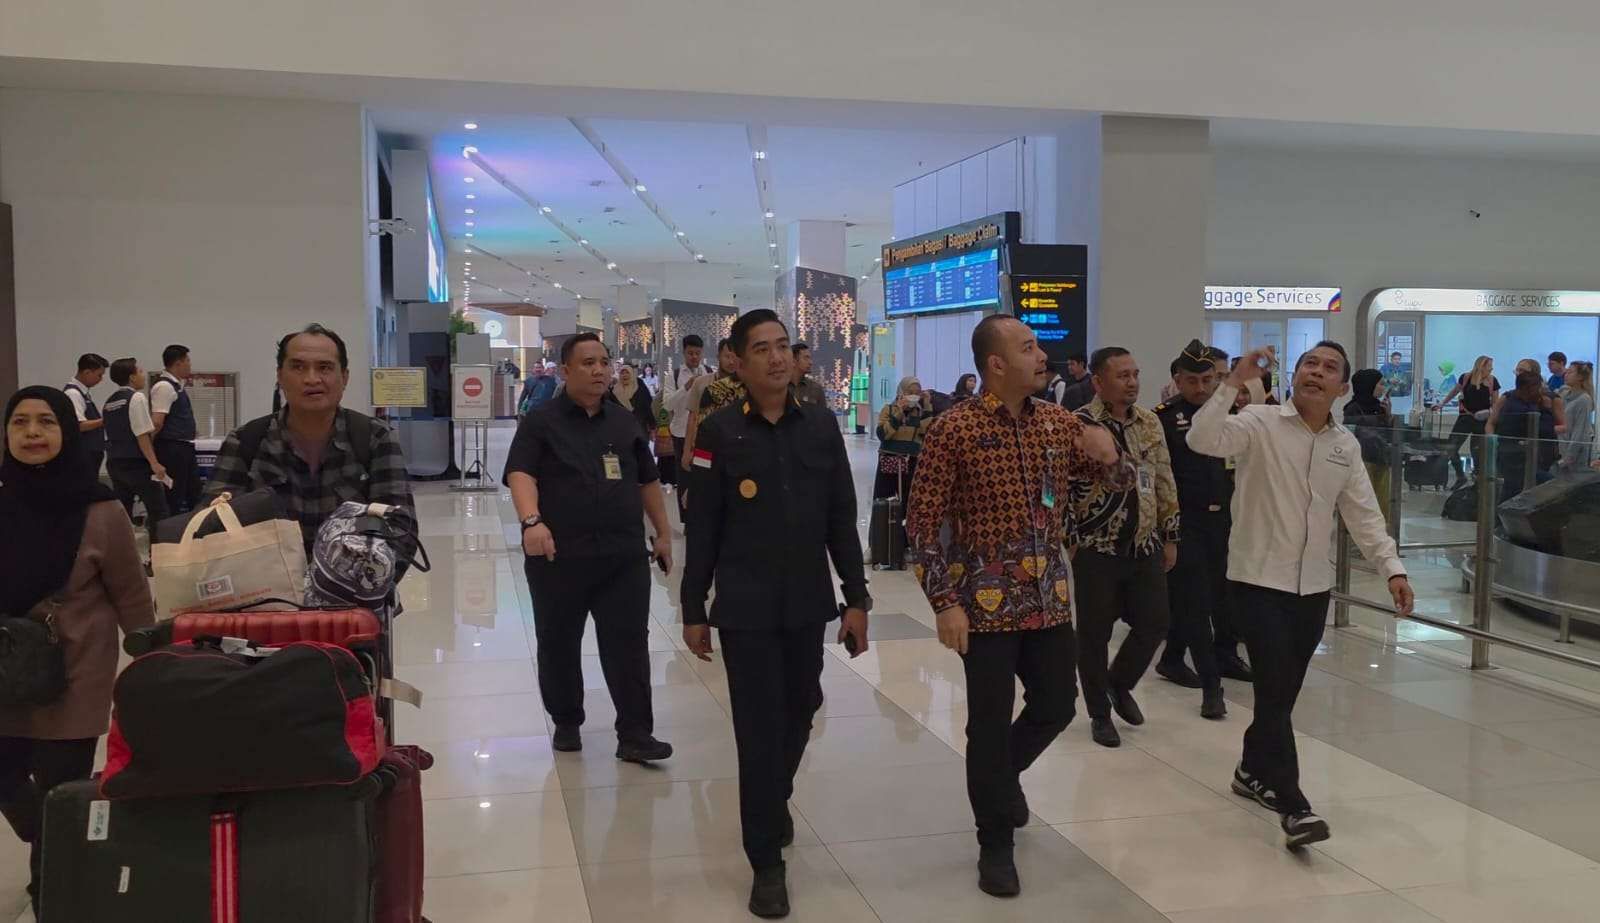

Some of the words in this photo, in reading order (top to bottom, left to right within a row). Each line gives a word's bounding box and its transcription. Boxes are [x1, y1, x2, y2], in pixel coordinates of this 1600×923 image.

[1257, 289, 1321, 304] Services
[1477, 294, 1517, 307] BAGGAGE
[1520, 295, 1560, 307] SERVICES
